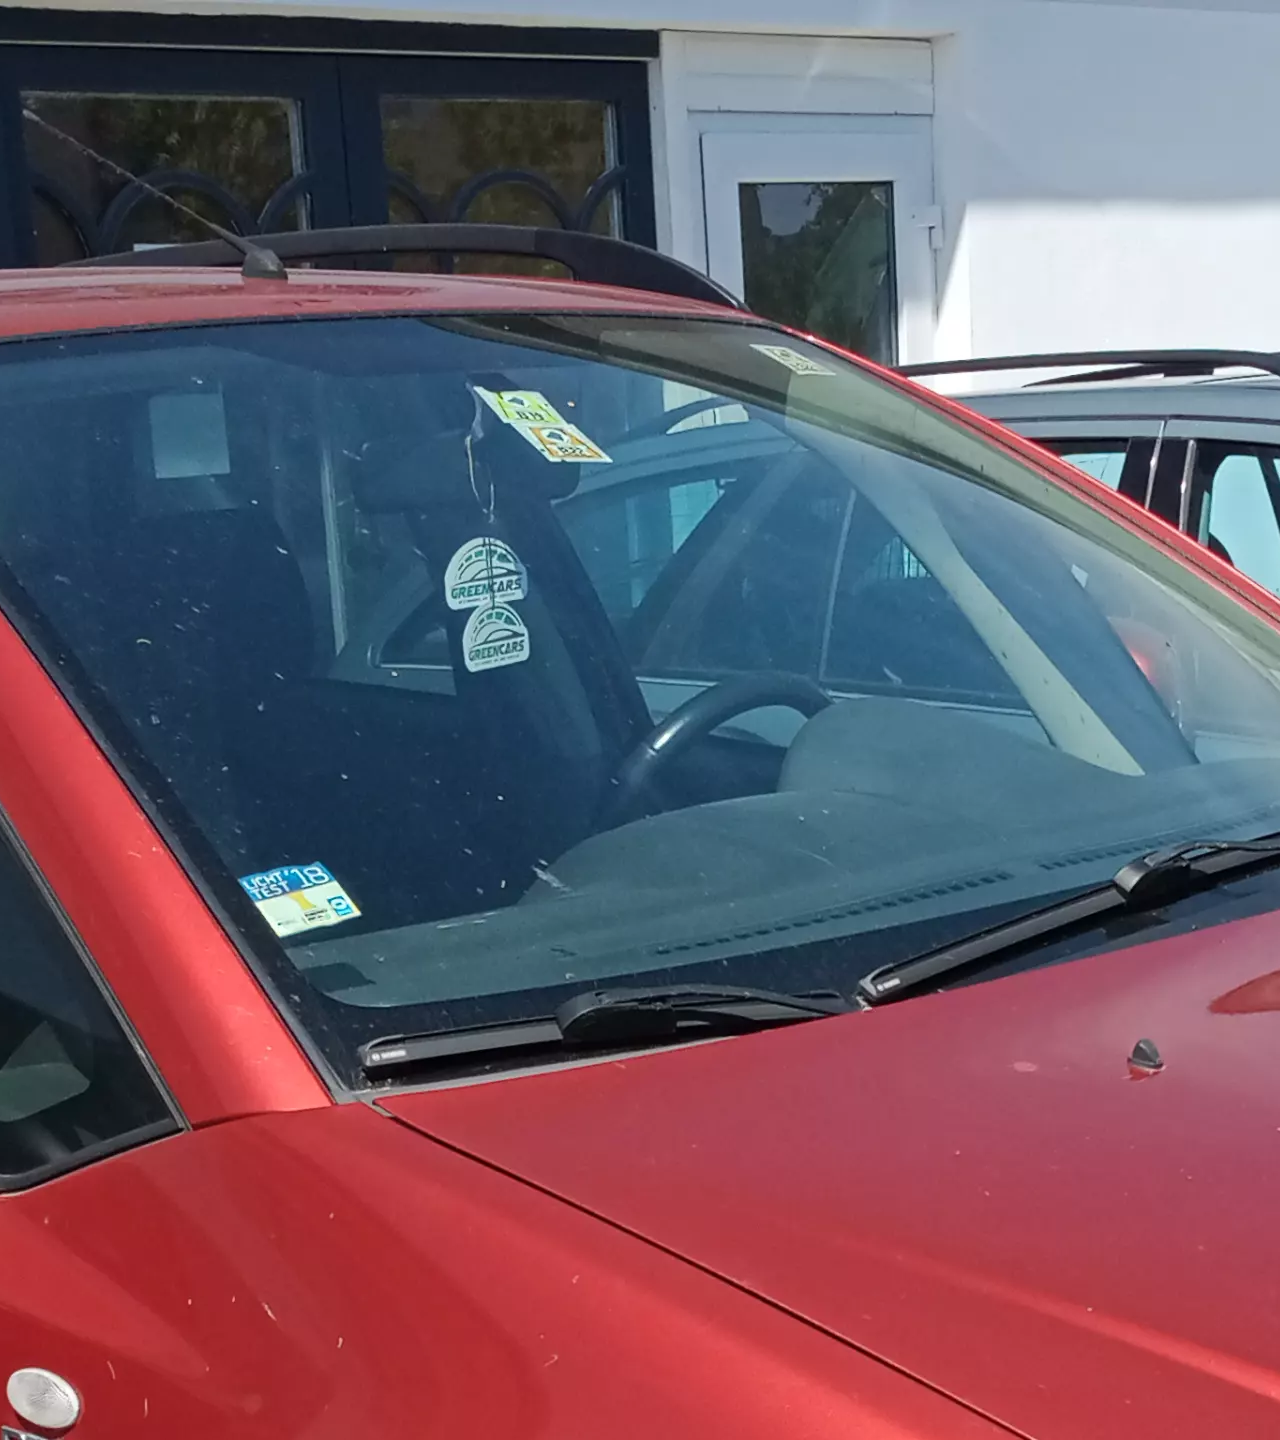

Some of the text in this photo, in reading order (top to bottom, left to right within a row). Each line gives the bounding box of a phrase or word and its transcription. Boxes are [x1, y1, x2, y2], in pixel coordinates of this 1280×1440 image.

[451, 577, 522, 600] GREENCARS
[469, 639, 525, 661] GREENCARS
[242, 871, 284, 891] LICHT
[250, 880, 291, 900] TEST
